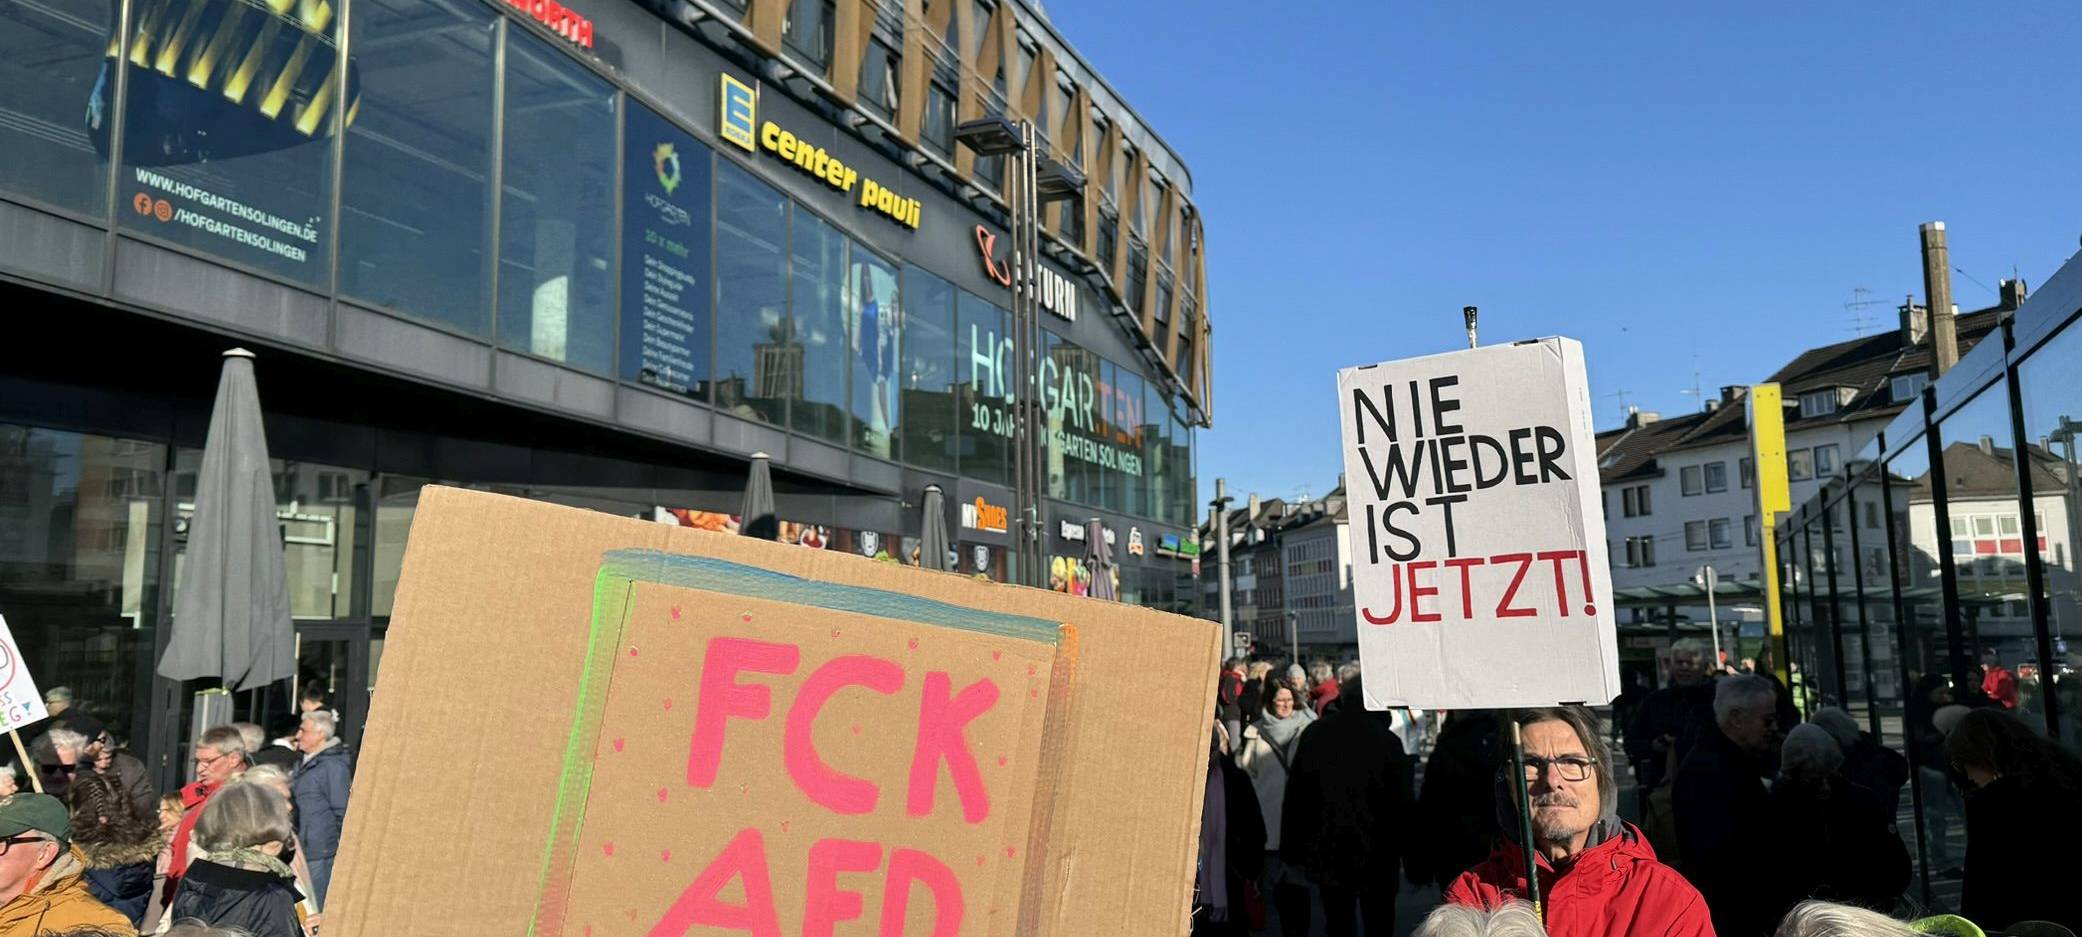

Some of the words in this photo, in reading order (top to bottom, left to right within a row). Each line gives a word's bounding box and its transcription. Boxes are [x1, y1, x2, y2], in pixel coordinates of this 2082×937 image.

[135, 167, 318, 243] WWW.HOFGARTENSOLINGEN.DE
[761, 120, 858, 192] center
[860, 177, 922, 230] pauli
[1016, 250, 1076, 322] TURN
[971, 323, 1142, 450] HOGARTEN
[1353, 375, 1464, 445] NIE
[972, 402, 990, 431] 10
[1098, 443, 1142, 477] SOLNGEN
[1358, 426, 1573, 501] WIEDER
[1366, 494, 1468, 565] IST
[1362, 550, 1597, 625] JETZT!
[686, 636, 1000, 825] FCK
[646, 827, 965, 937] AFD
